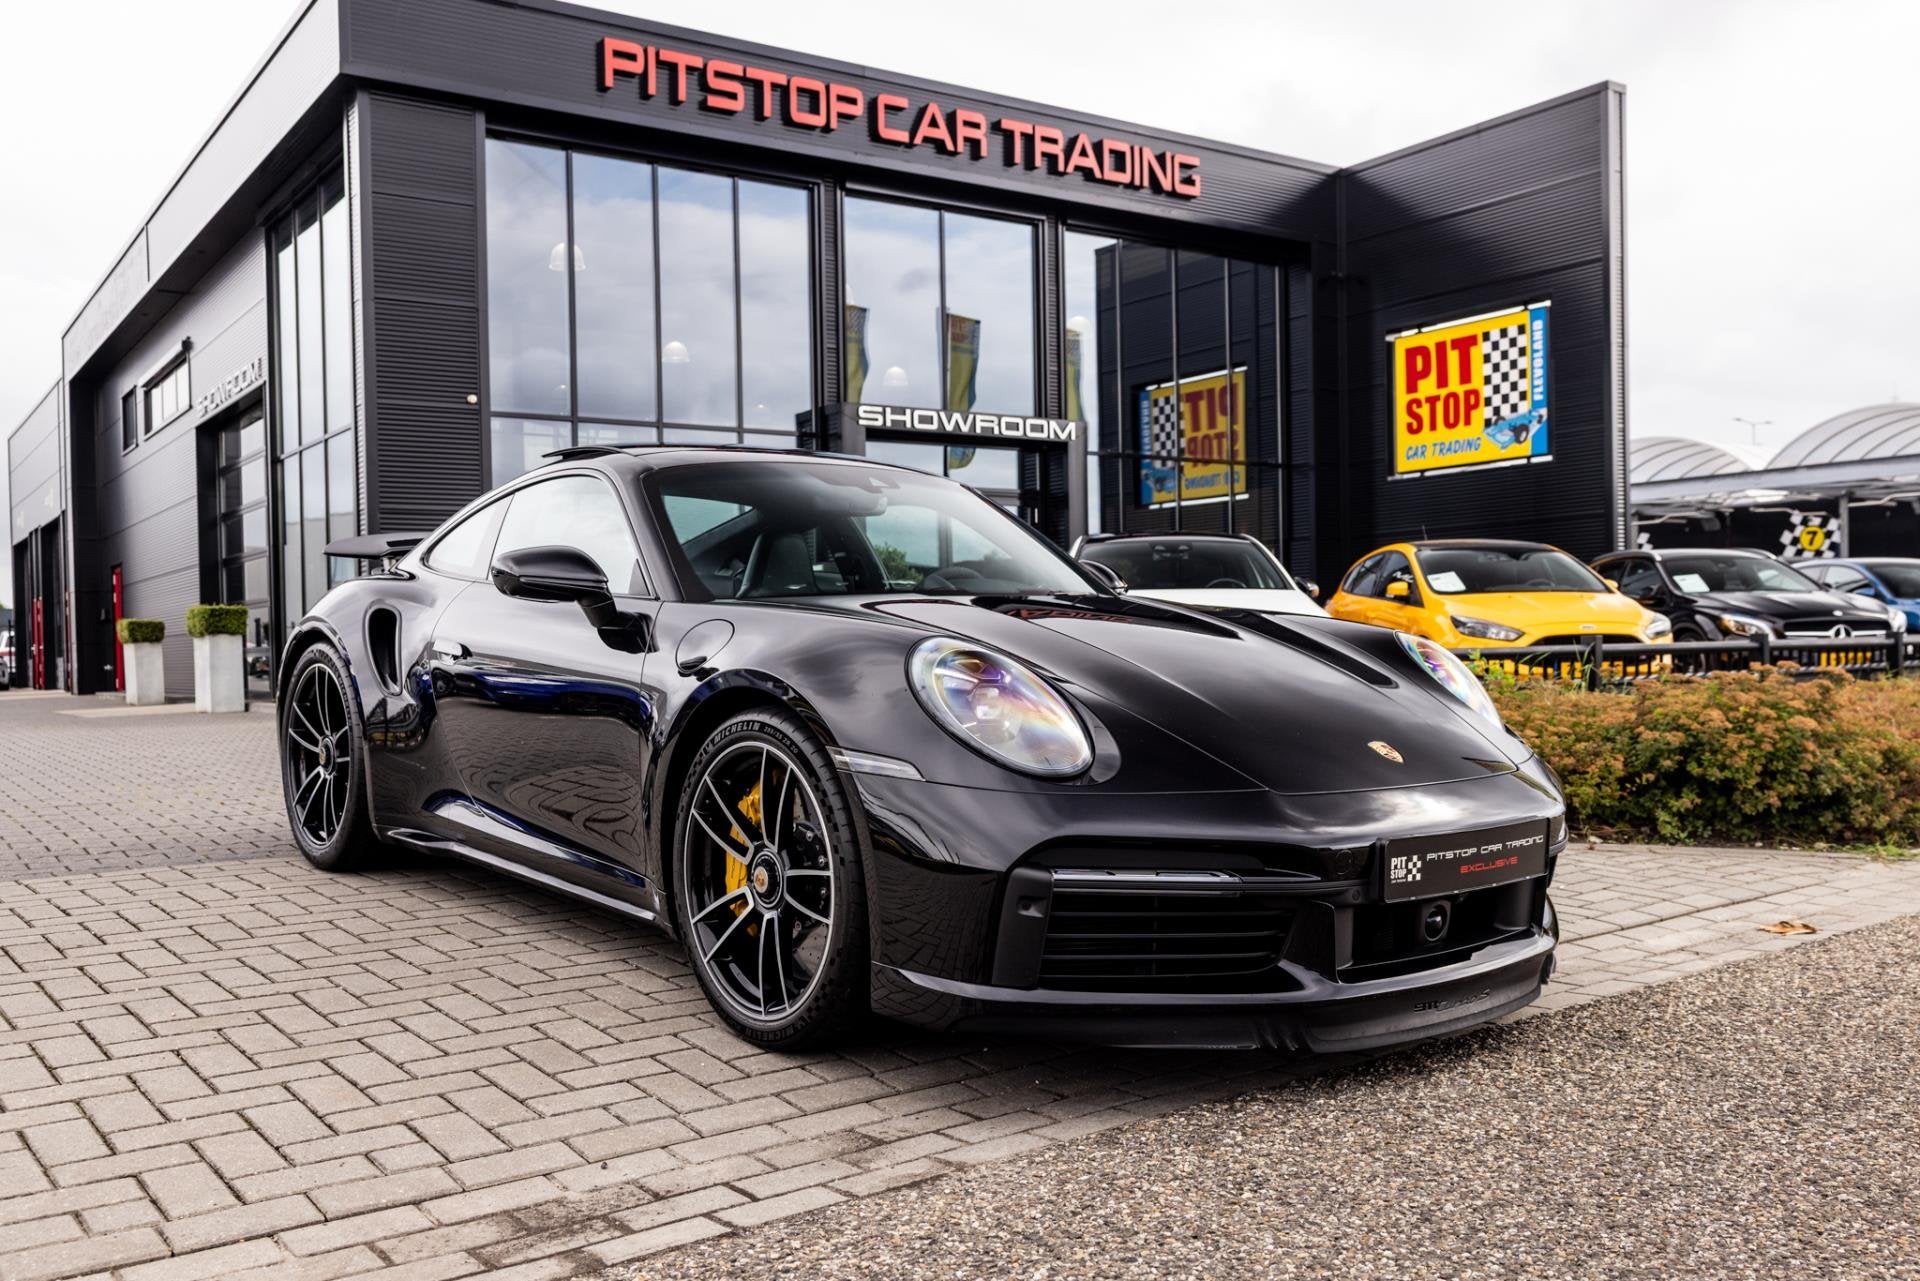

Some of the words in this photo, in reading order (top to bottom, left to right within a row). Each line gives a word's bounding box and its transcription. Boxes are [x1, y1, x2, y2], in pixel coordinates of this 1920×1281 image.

[600, 37, 864, 131] PITSTOP
[874, 93, 988, 159] CAR
[998, 118, 1201, 198] TRADING
[1404, 334, 1478, 395] PIT
[1532, 319, 1544, 401] FLEVOLAND
[857, 405, 1076, 441] SHOWROOM
[1406, 388, 1481, 436] STOP
[1405, 444, 1427, 461] CAR
[1431, 437, 1482, 457] TRADING
[1807, 530, 1818, 546] 7
[714, 721, 761, 744] MICHELIN
[1426, 847, 1477, 862] PITSTOP
[1481, 843, 1503, 854] CAR
[1506, 835, 1544, 849] TRADING
[1390, 868, 1407, 879] STOP
[1391, 856, 1407, 870] PIT
[1460, 856, 1519, 874] EXCLUSIVE
